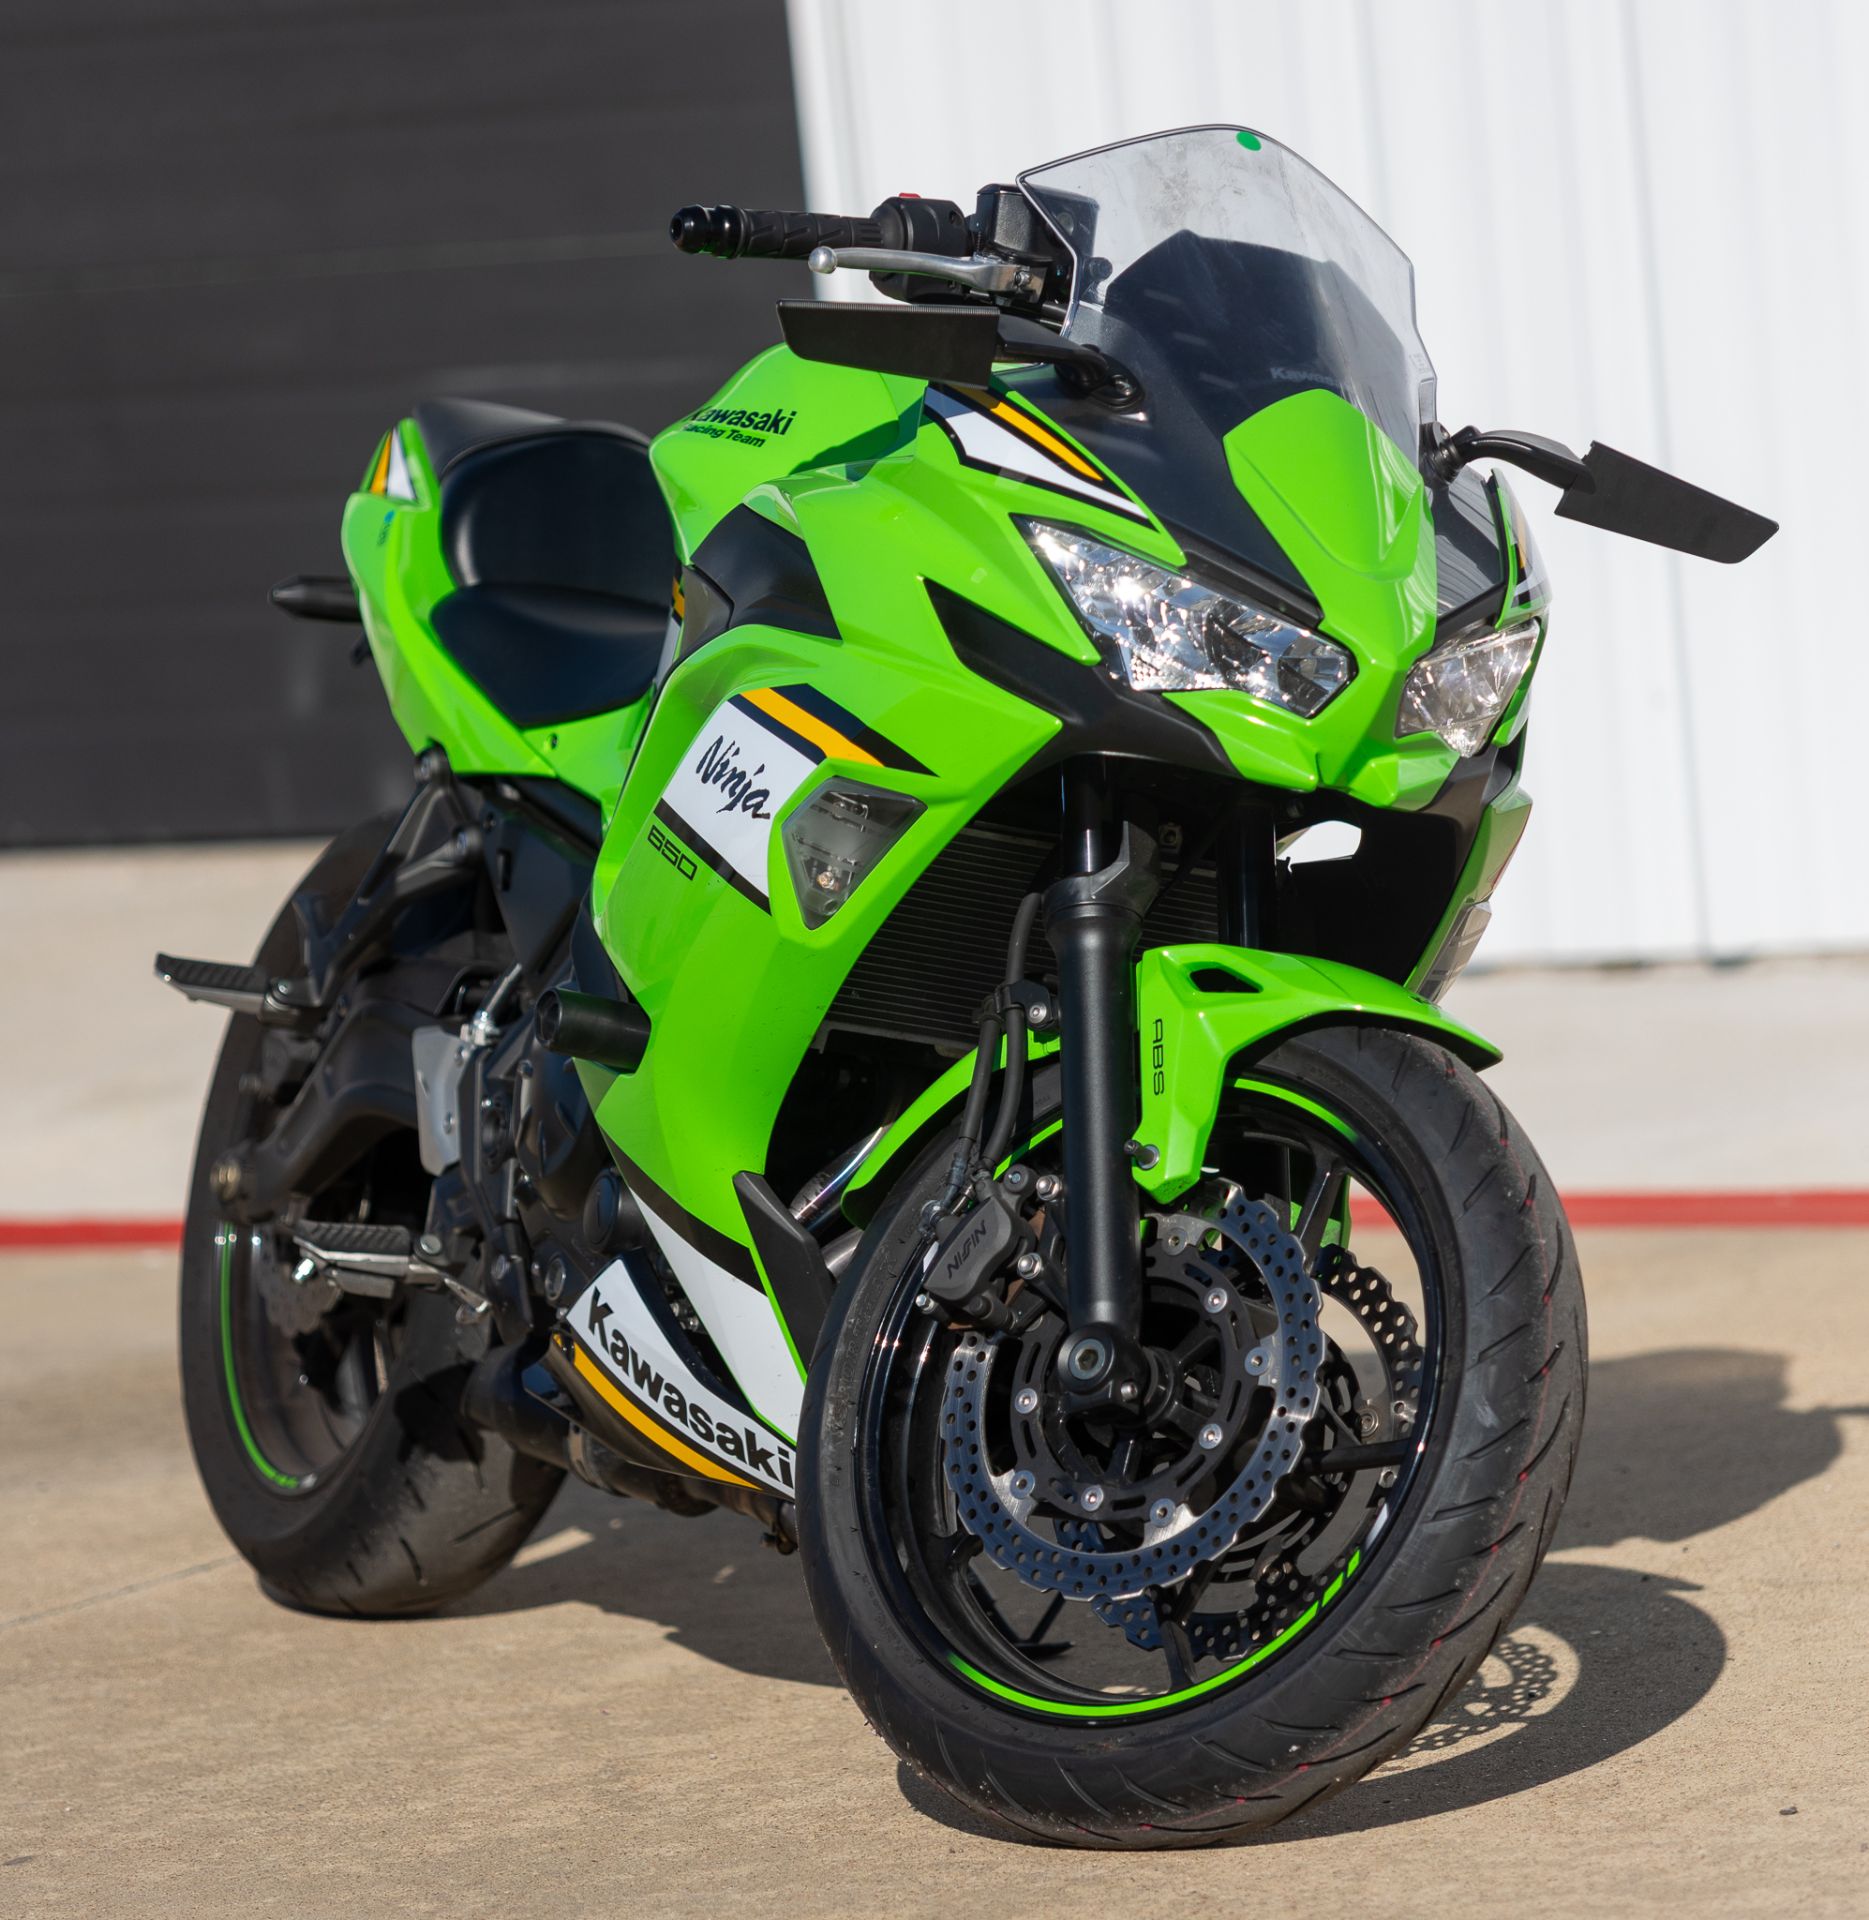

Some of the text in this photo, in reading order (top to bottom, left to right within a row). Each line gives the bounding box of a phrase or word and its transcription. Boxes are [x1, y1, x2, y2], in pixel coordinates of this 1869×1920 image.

[725, 429, 766, 448] Team
[695, 734, 770, 820] Ninja
[647, 824, 698, 881] 650
[1152, 1018, 1165, 1096] ABS
[945, 1219, 988, 1279] NISSIN
[588, 1286, 794, 1490] Kawasaki
